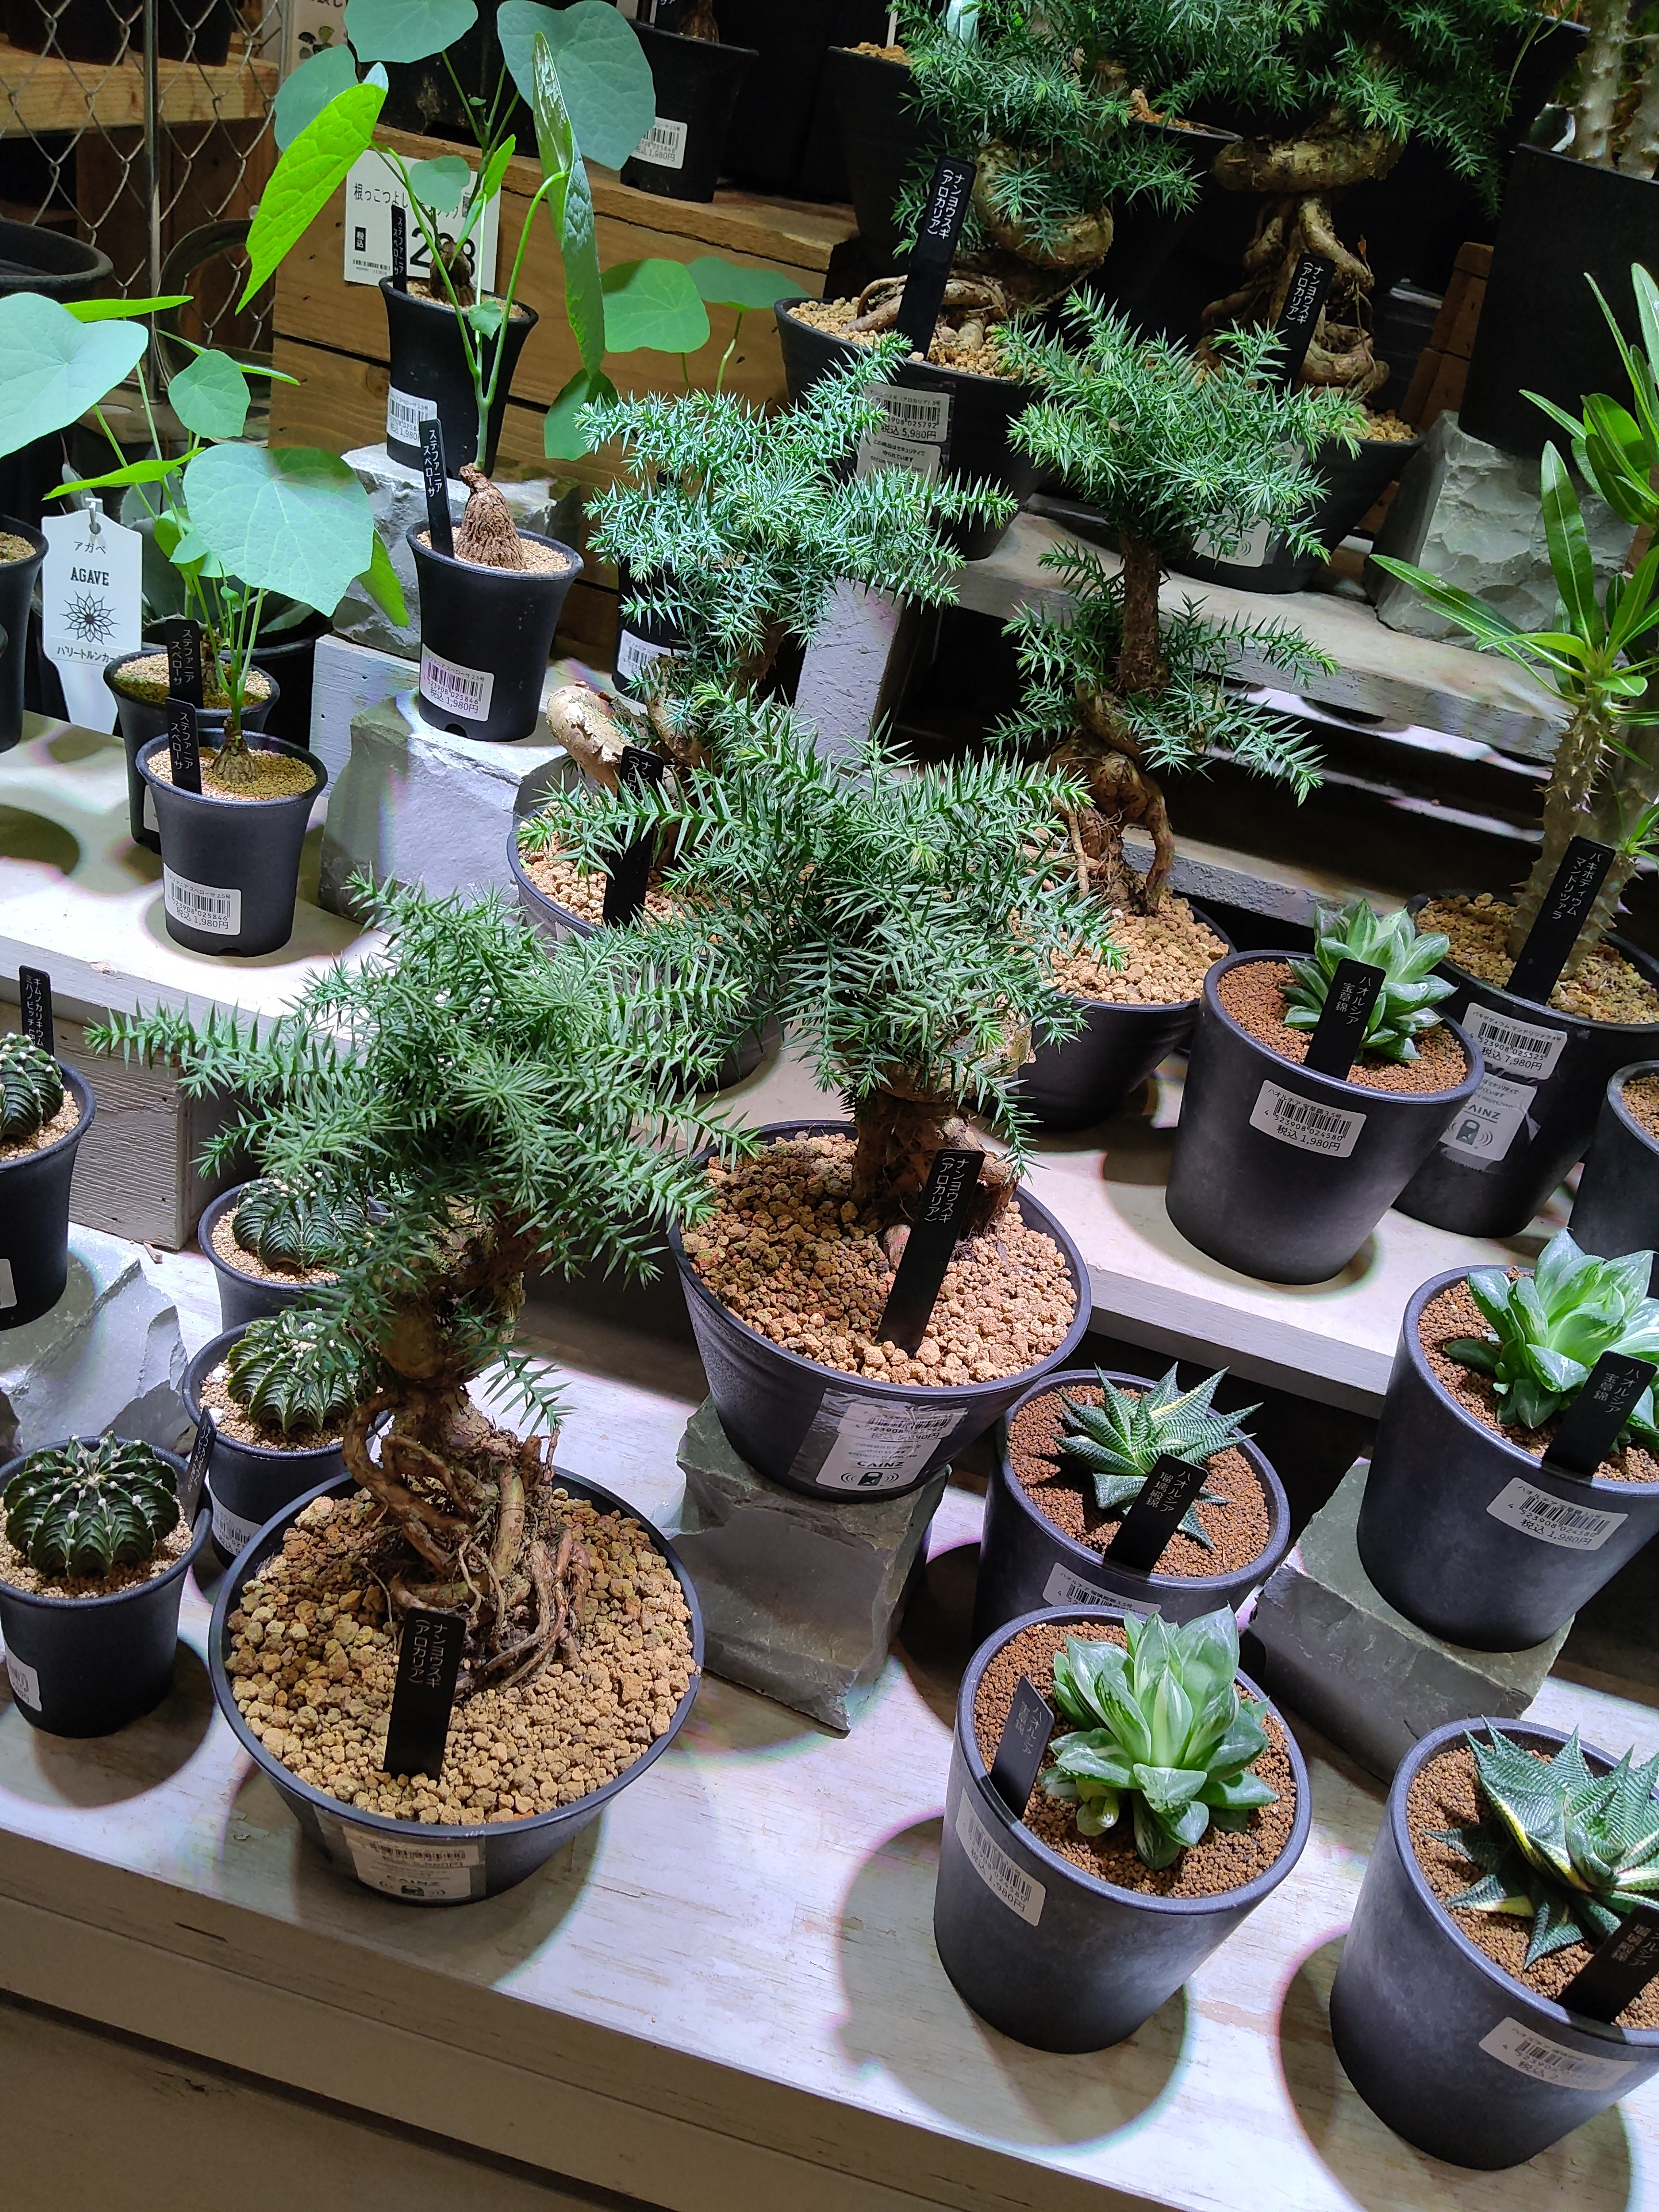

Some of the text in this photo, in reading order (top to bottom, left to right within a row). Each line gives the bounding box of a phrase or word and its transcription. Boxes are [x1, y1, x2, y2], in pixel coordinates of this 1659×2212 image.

[938, 174, 965, 240] ナンヨウスギ
[397, 216, 405, 275] ステファニア
[1297, 266, 1324, 325] ナンヨウスギ
[881, 423, 937, 440] 税込 5,980円
[907, 420, 937, 429] 025792
[423, 445, 435, 497] スペローサ
[429, 429, 443, 493] ステファニア
[73, 541, 107, 554] アガベ
[70, 566, 110, 587] AGAVE
[171, 641, 183, 685] スペローサ
[182, 629, 195, 683] ステファニア
[446, 665, 470, 678] スペローサ
[430, 687, 479, 714] 税込 1,980円
[451, 691, 479, 705] 025846
[171, 722, 183, 769] スペローサ
[180, 712, 193, 769] ステファニア
[189, 887, 216, 897] スペローサ
[1552, 857, 1587, 919] マンドリツァラ
[1565, 852, 1603, 916] パキポディウム
[176, 906, 228, 930] 税込 1,980円
[197, 910, 228, 921] 025846
[34, 978, 44, 1047] ギムノカリキウム
[1335, 982, 1355, 1012] 宝草錦
[1346, 976, 1371, 1024] ハオルシア
[1478, 1037, 1510, 1053] 523908
[1512, 1050, 1544, 1061] 025525
[1481, 1046, 1542, 1071] 税込 7,980円
[1268, 1088, 1301, 1106] ハオルチア
[1324, 1110, 1342, 1119] 3.5号
[1467, 1104, 1501, 1120] AINZ
[1274, 1115, 1306, 1132] 523908
[1309, 1130, 1343, 1142] 024580
[1276, 1124, 1341, 1151] 税込 1,980円
[938, 1158, 969, 1224] ナンヨウスギ
[1605, 1369, 1640, 1413] ハオルシア
[1145, 1472, 1174, 1508] 瑠璃殿錦
[1160, 1471, 1191, 1512] ハオルシア
[1518, 1485, 1558, 1505] ハオルチア
[1520, 1509, 1556, 1529] 523908
[1560, 1527, 1596, 1538] 024580
[1520, 1518, 1592, 1546] 税込 1,980円
[1060, 1572, 1090, 1591] ハオルチア
[1022, 1707, 1042, 1755] ハオルシア
[988, 1873, 1026, 1913] 1,980円
[994, 1870, 1026, 1902] 024580
